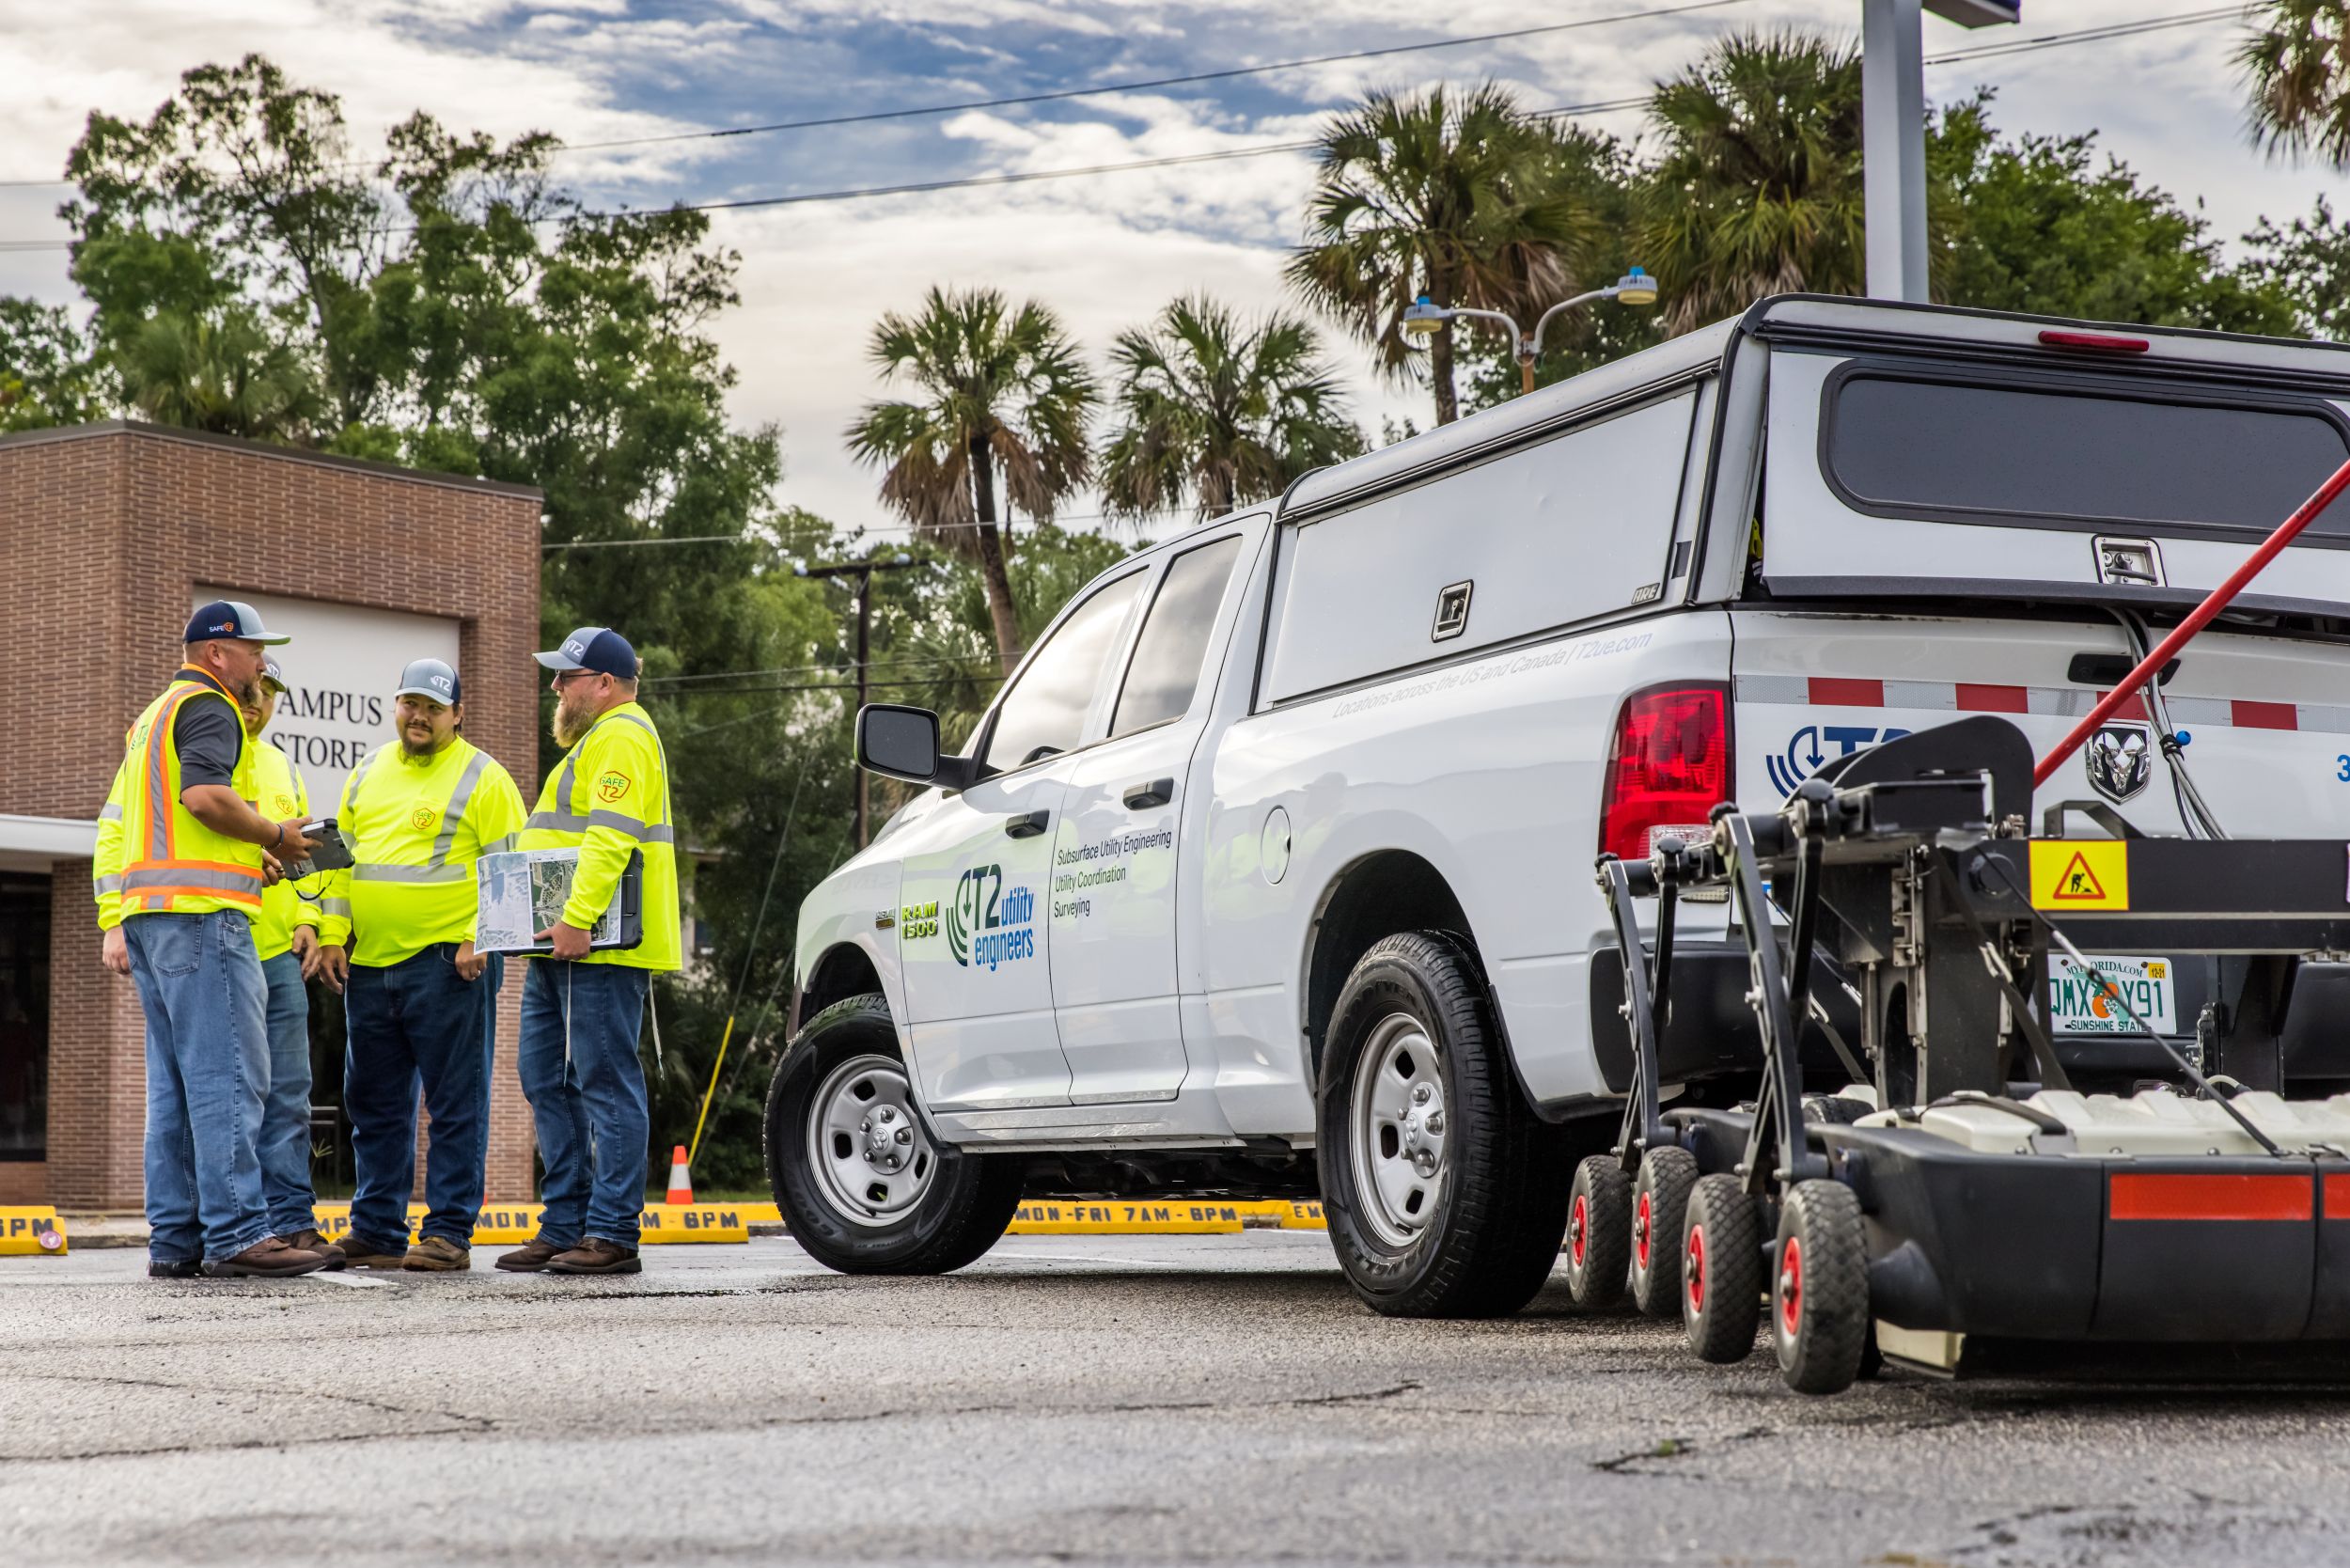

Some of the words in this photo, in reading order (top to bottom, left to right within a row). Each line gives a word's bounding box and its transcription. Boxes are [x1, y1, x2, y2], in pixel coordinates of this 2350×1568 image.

[1635, 585, 1659, 603] ARE
[1332, 694, 1391, 718] Locations
[1390, 681, 1434, 703] across
[1435, 672, 1460, 693] the
[1460, 666, 1484, 686] US
[1480, 658, 1510, 681] and
[1510, 648, 1567, 674] Canada
[1576, 633, 1653, 660] T2ue.com
[277, 686, 382, 727] AMPUS
[602, 776, 625, 788] SAFE
[603, 784, 620, 798] T2
[417, 817, 429, 827] T2
[1057, 846, 1099, 866] Subsurface
[1100, 839, 1122, 859] Utility
[1123, 828, 1172, 854] Engineering
[1055, 872, 1076, 892] Utility
[1077, 865, 1126, 888] Coordination
[972, 863, 1002, 931] T2
[1001, 886, 1034, 925] utility
[1054, 897, 1090, 918] Surveying
[901, 900, 939, 921] RAM
[901, 918, 939, 939] 1500
[975, 926, 1034, 972] engineers
[2122, 980, 2164, 1018] Y91
[2070, 1019, 2115, 1032] SUNSHINE
[1123, 1207, 1170, 1222] 7AM
